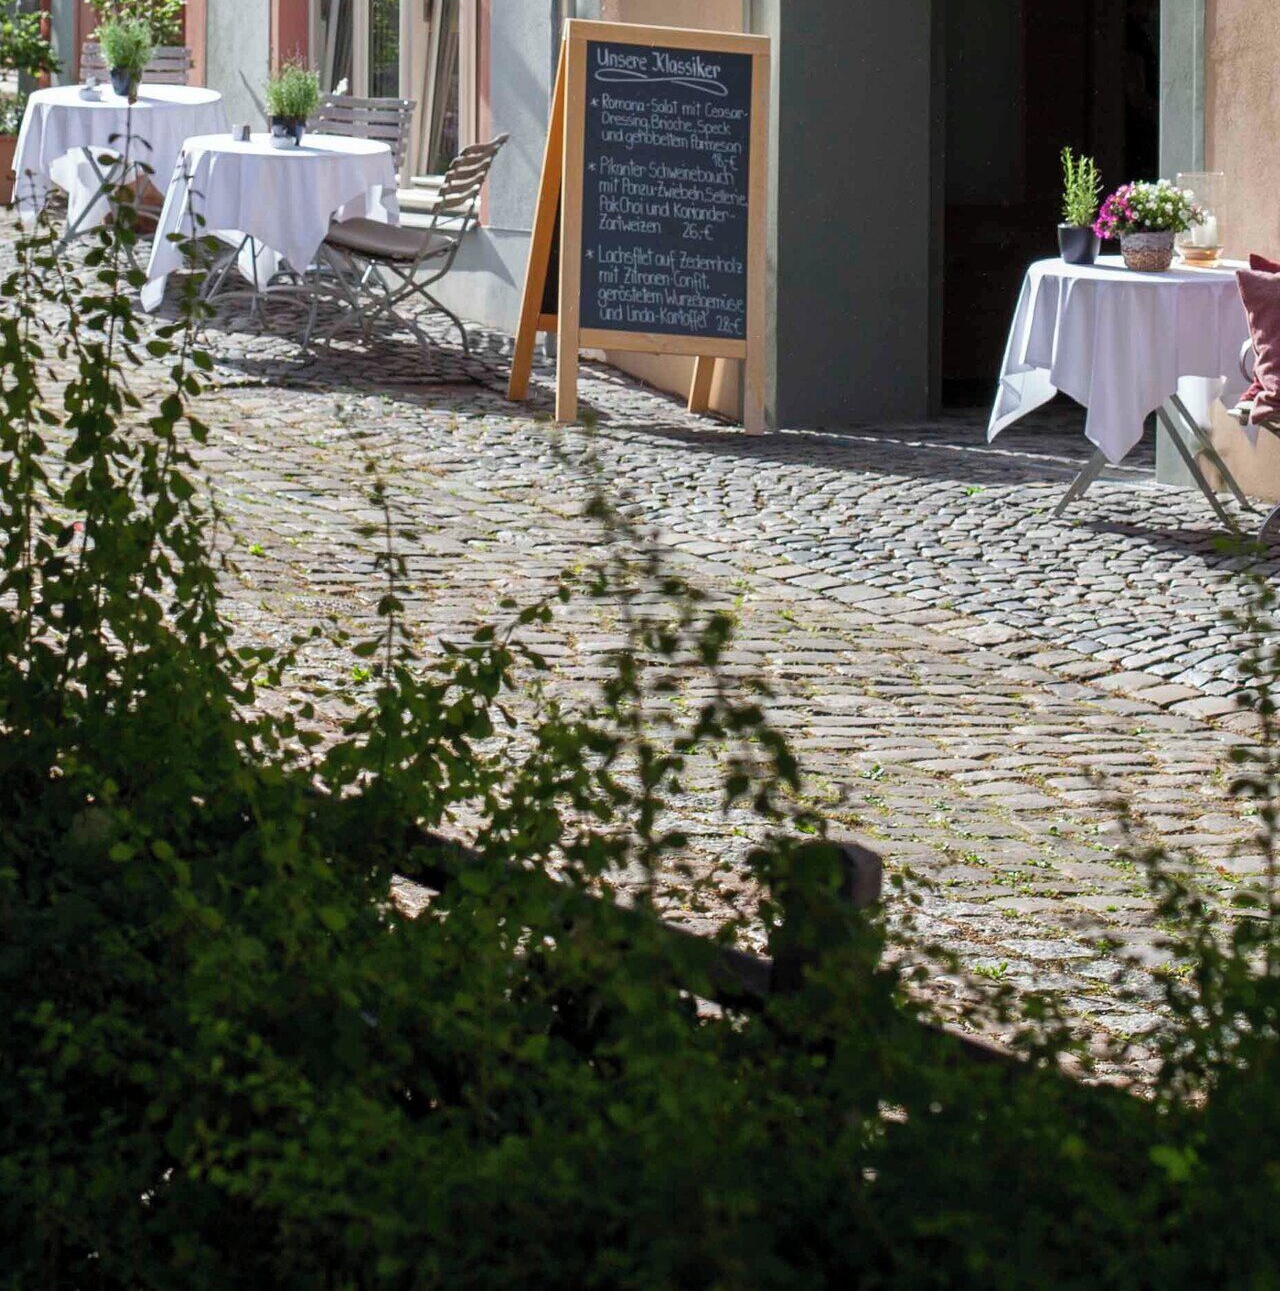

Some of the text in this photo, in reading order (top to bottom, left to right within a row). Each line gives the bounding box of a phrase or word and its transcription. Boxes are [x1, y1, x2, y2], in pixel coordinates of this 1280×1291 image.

[596, 47, 722, 79] Unsere Klassiker
[602, 93, 679, 115] Romana-Salat
[682, 101, 701, 117] mit
[601, 128, 624, 143] und
[690, 133, 743, 155] Parmesan
[697, 119, 731, 141] Speck
[600, 155, 735, 185] Pikanter Schweinebauch
[599, 177, 618, 193] mit
[600, 194, 619, 213] Pak
[645, 201, 670, 217] und
[599, 212, 662, 235] Zartweizen
[598, 243, 744, 274] Lachsfilet auf Zedernholz
[599, 264, 618, 283] mit
[597, 284, 745, 315] geröstetem Wurzelgemüse
[600, 304, 622, 321] und
[627, 304, 707, 331] Linda-Kartoffel
